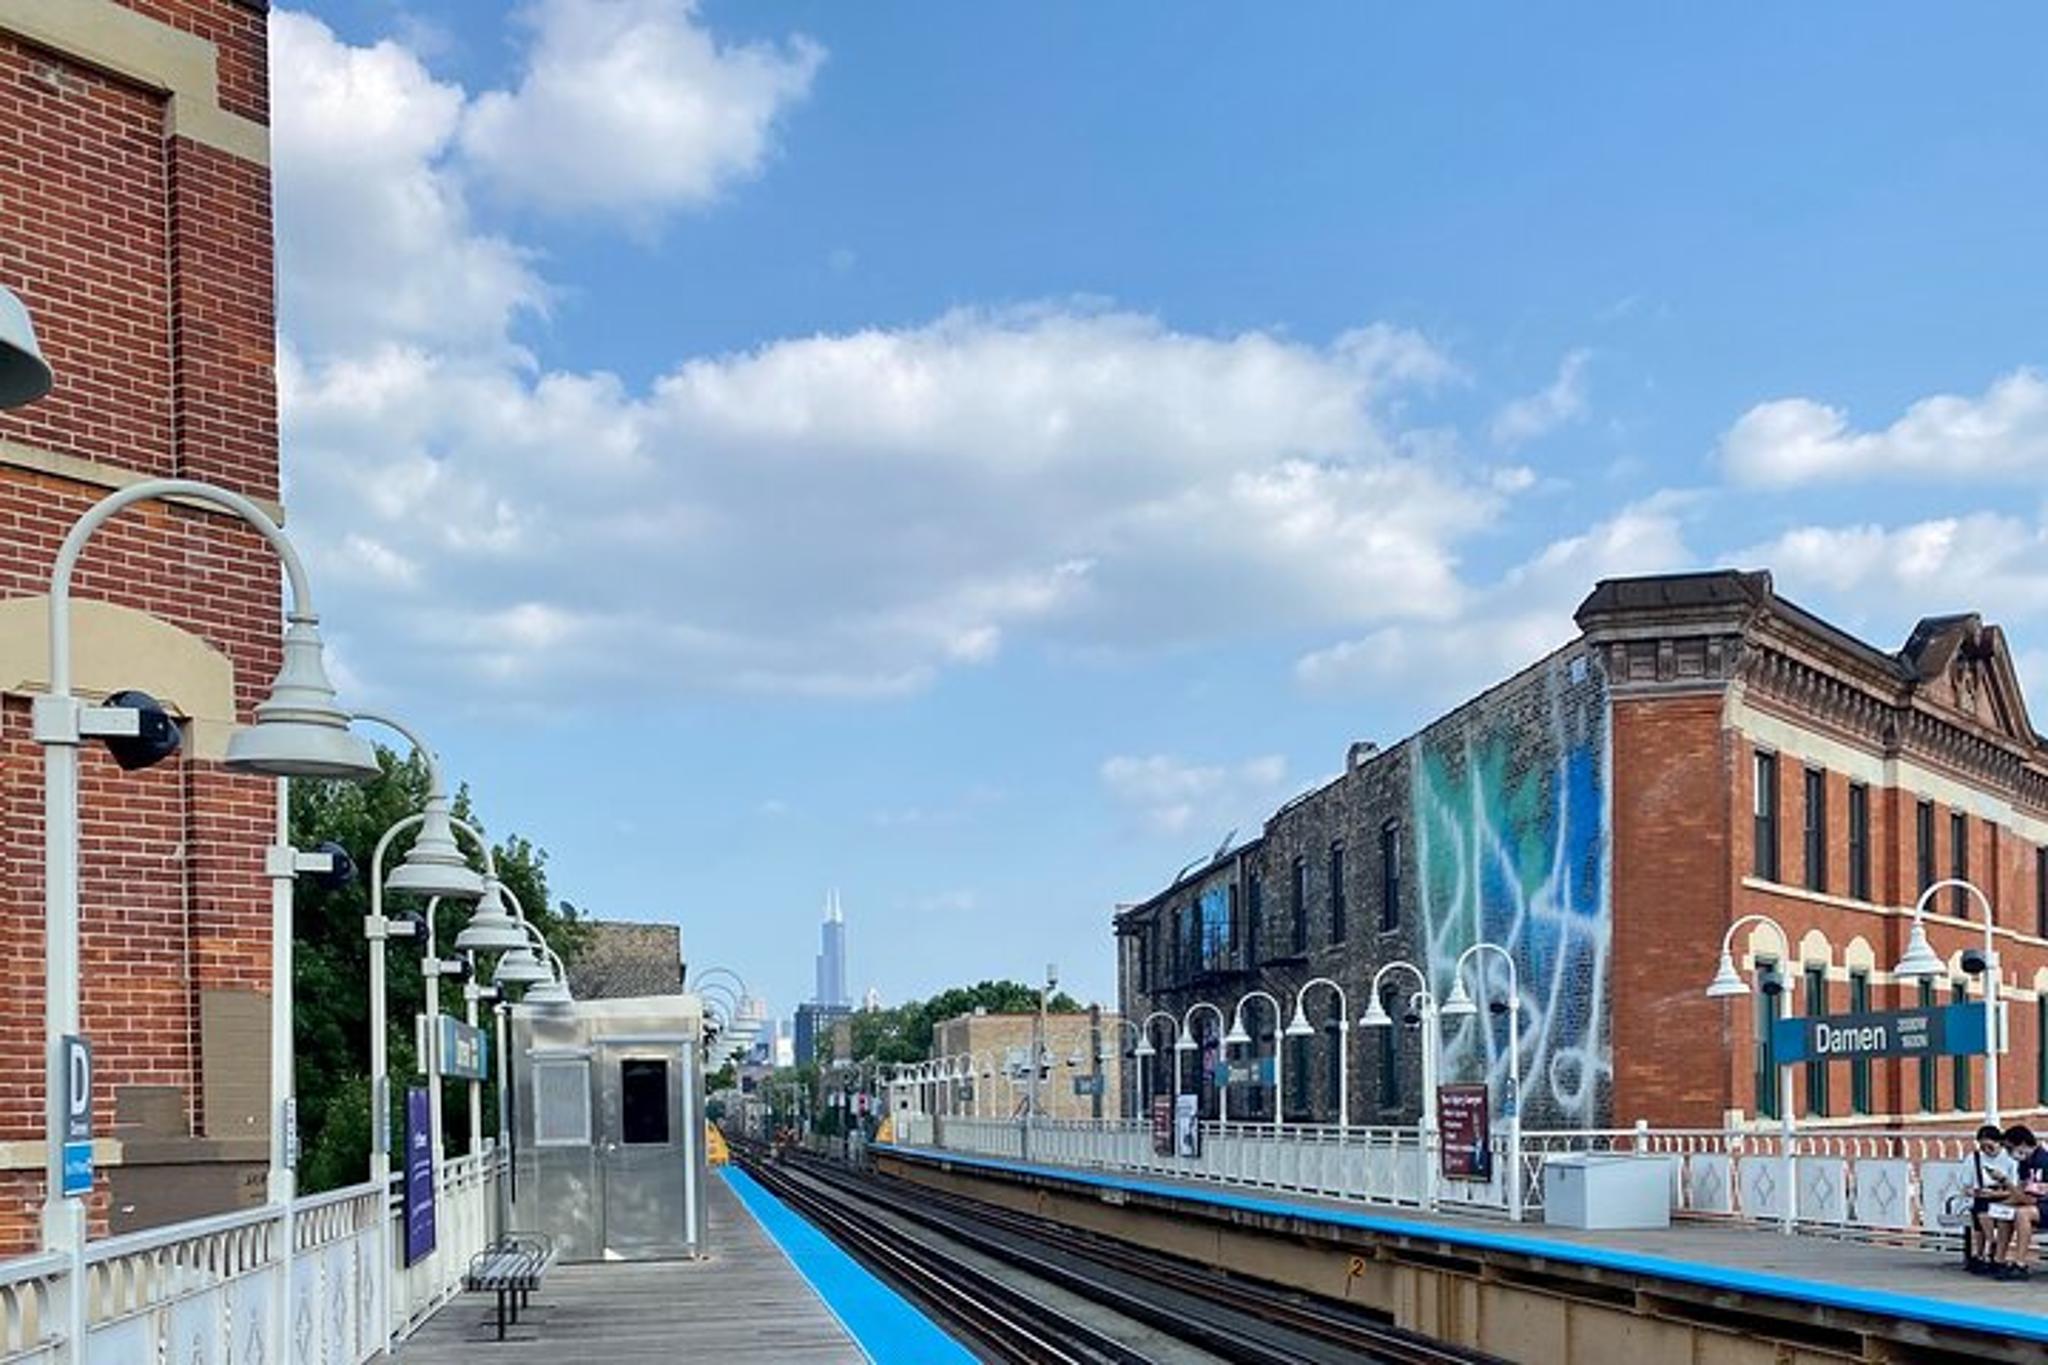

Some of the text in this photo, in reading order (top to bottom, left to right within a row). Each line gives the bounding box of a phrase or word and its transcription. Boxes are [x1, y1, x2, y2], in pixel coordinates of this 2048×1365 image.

[1816, 1022, 1887, 1054] Damen
[71, 1043, 89, 1116] D
[1351, 1259, 1363, 1278] 2
